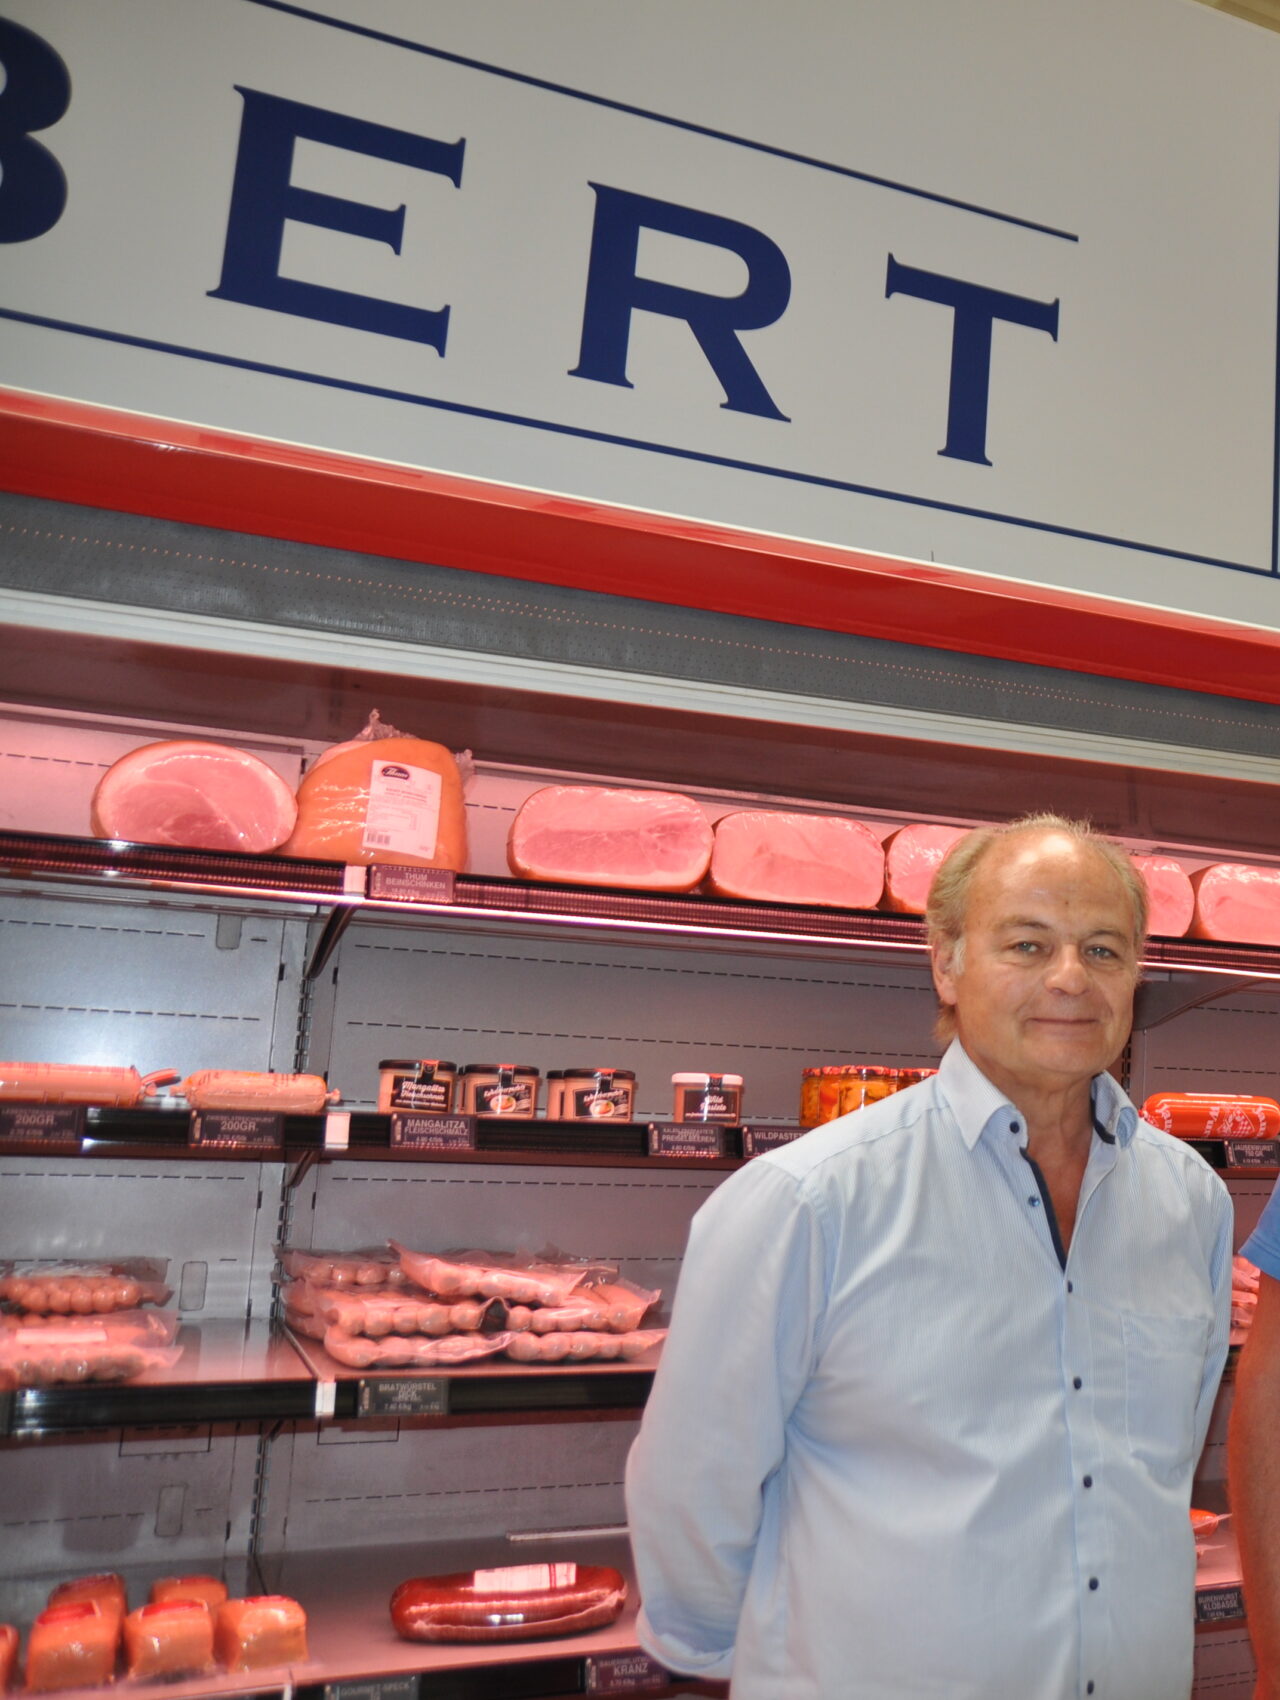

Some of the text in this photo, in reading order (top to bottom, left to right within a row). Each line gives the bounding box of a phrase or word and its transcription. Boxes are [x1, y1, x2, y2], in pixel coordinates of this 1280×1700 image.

[404, 872, 428, 881] THUM
[385, 877, 446, 889] BEINSCHINKEN
[220, 1120, 259, 1132] 200GR.
[407, 1119, 466, 1129] MANGALITZA
[404, 1126, 469, 1136] FLEISCHSCHMALZ
[613, 1662, 649, 1676] KRANZ
